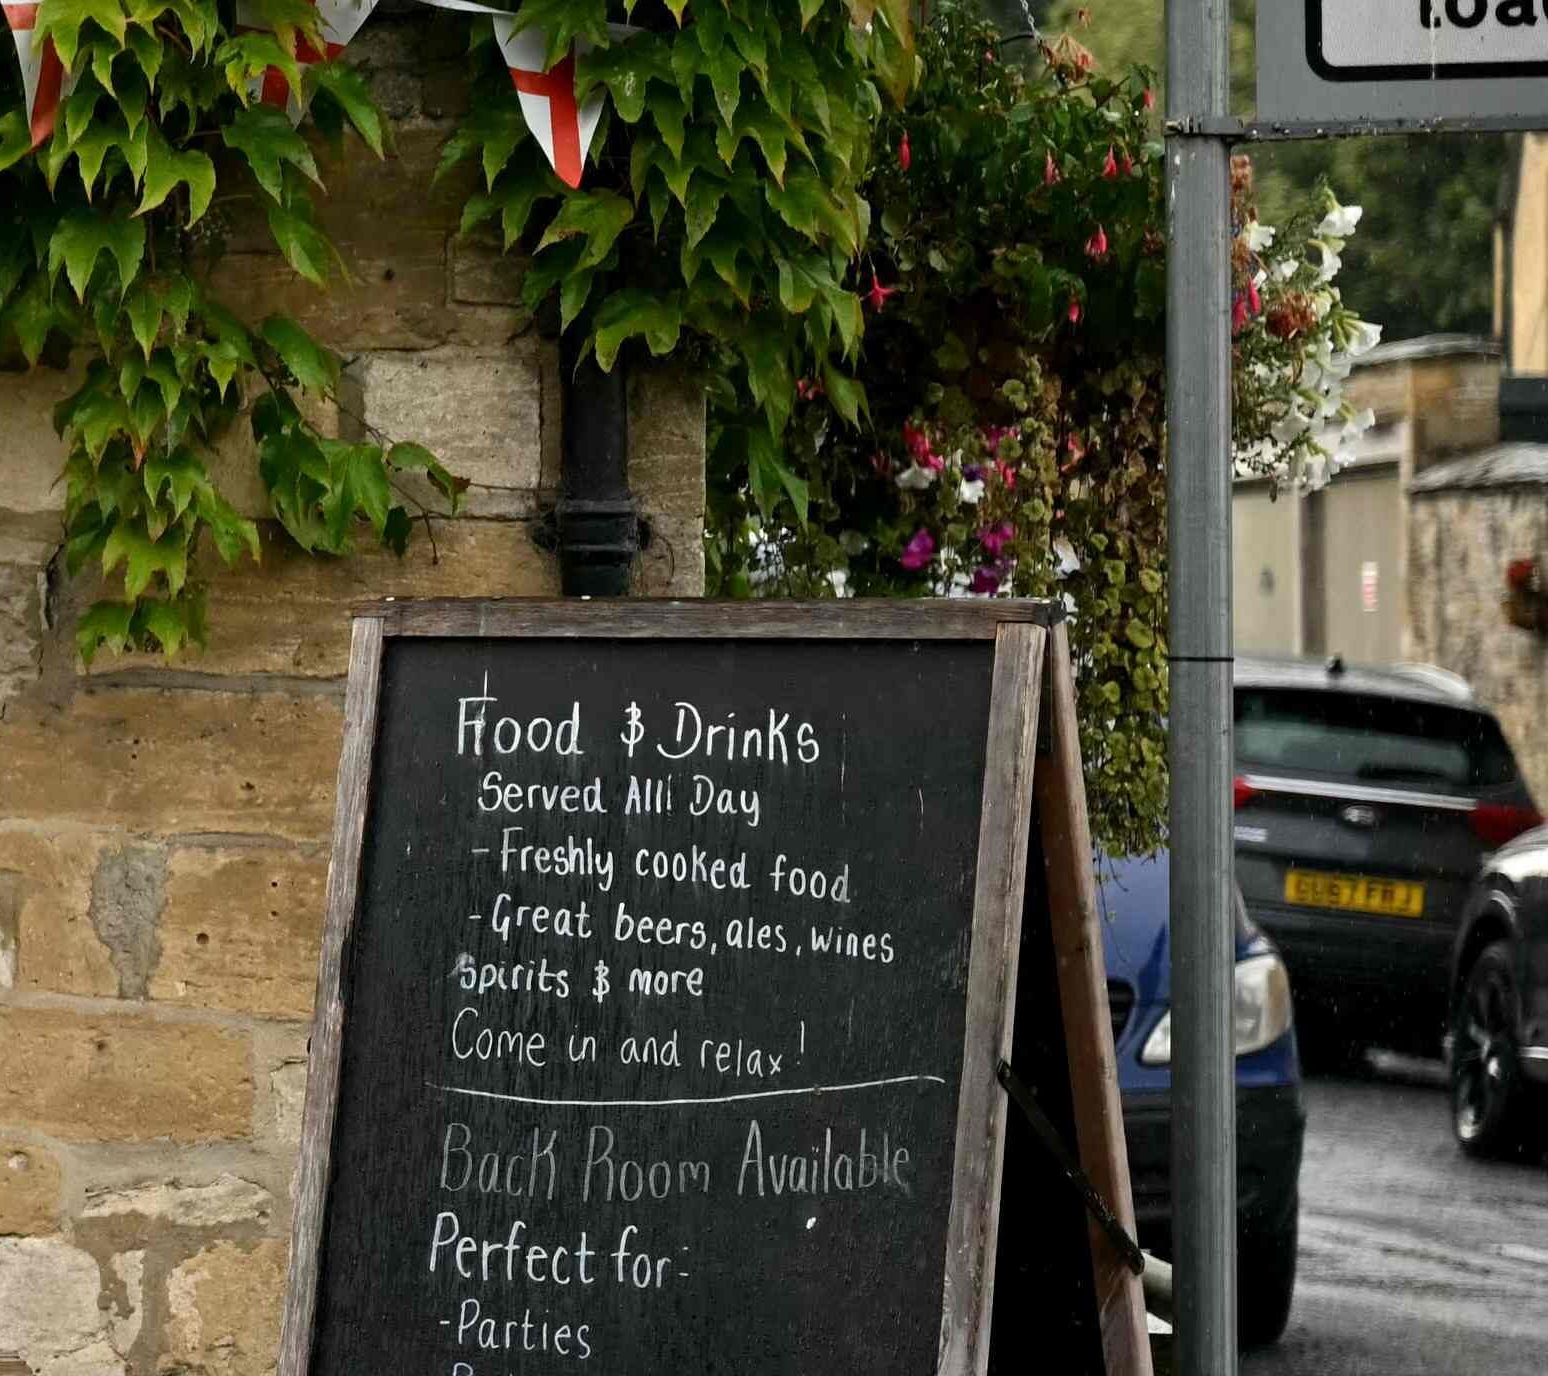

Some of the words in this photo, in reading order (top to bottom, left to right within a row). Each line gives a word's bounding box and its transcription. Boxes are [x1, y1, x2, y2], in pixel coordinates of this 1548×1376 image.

[458, 697, 584, 757] Food
[657, 701, 820, 766] Drinks
[477, 771, 607, 815] Served
[690, 774, 760, 827] Day
[636, 844, 751, 890] cooked
[769, 854, 852, 903] food
[615, 902, 717, 955] beers,
[811, 925, 895, 964] wines
[629, 967, 704, 997] more
[452, 1007, 546, 1067] Come
[569, 1024, 596, 1065] in
[620, 1029, 681, 1067] and
[440, 1122, 558, 1201] Back
[583, 1125, 710, 1202] Room
[737, 1119, 911, 1196] Available
[429, 1211, 596, 1285] Perfect
